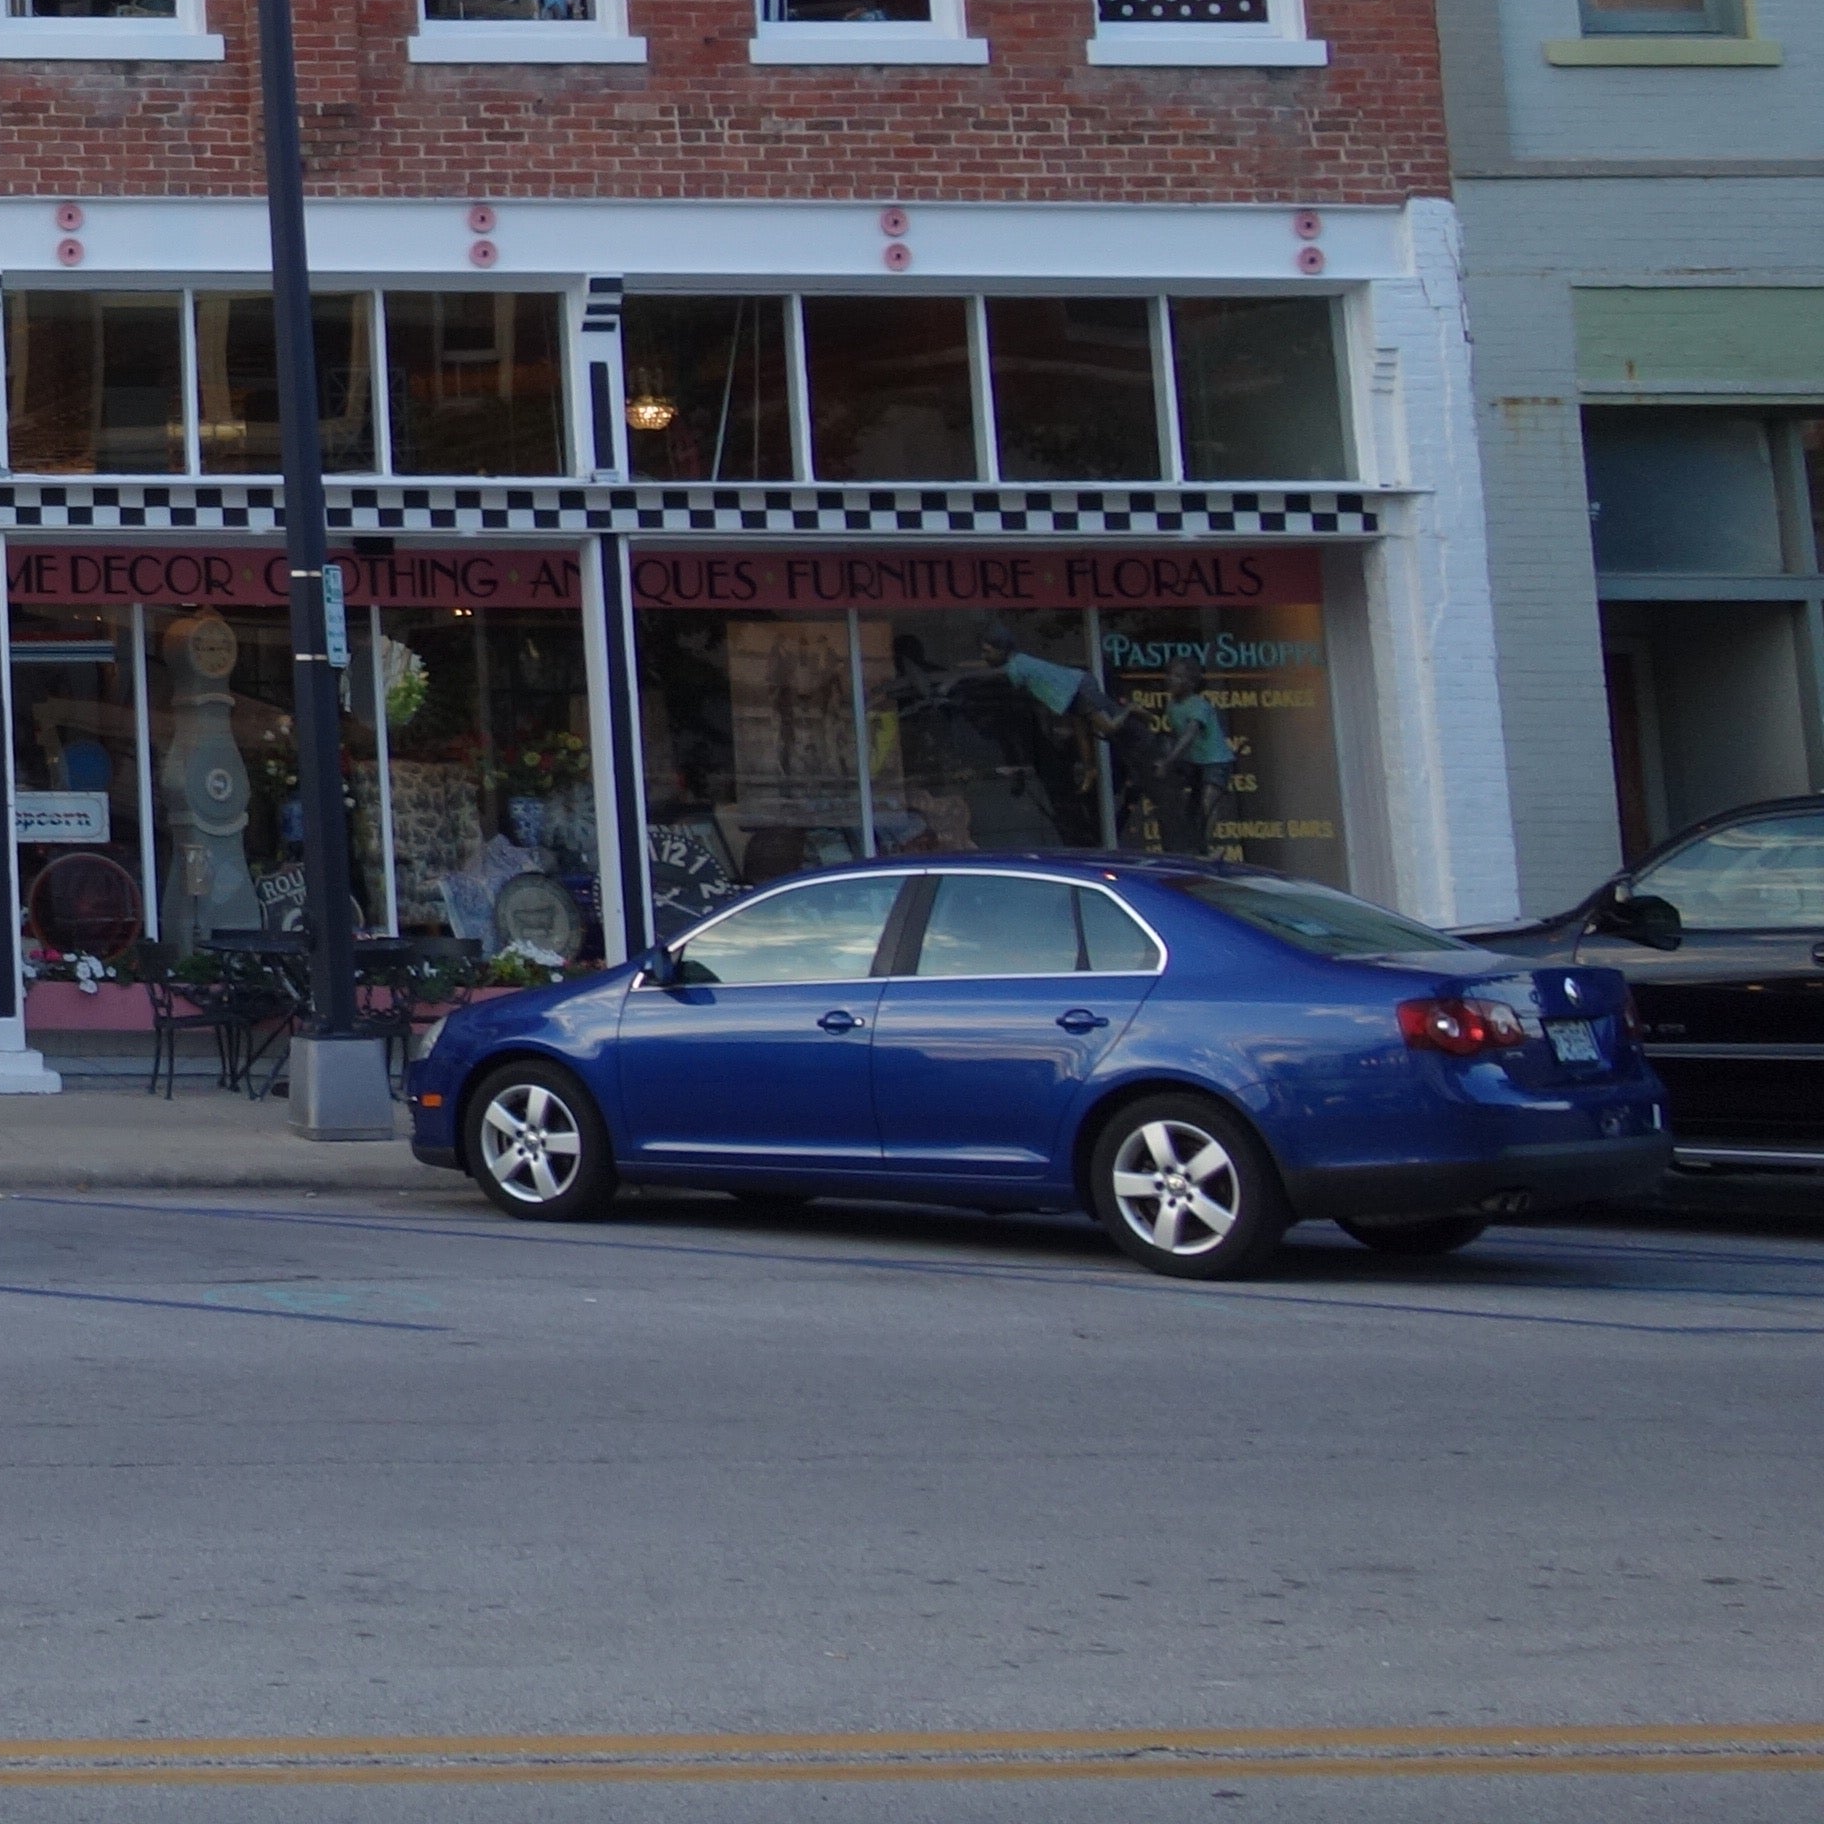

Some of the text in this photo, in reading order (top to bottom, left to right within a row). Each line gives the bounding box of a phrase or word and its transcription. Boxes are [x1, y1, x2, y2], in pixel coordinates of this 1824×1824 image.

[71, 555, 234, 596] DECOR
[265, 556, 498, 597] COTHING
[530, 559, 756, 605] ANQUES
[787, 559, 1034, 600] FURNITURE
[1065, 557, 1263, 598] FLORALS
